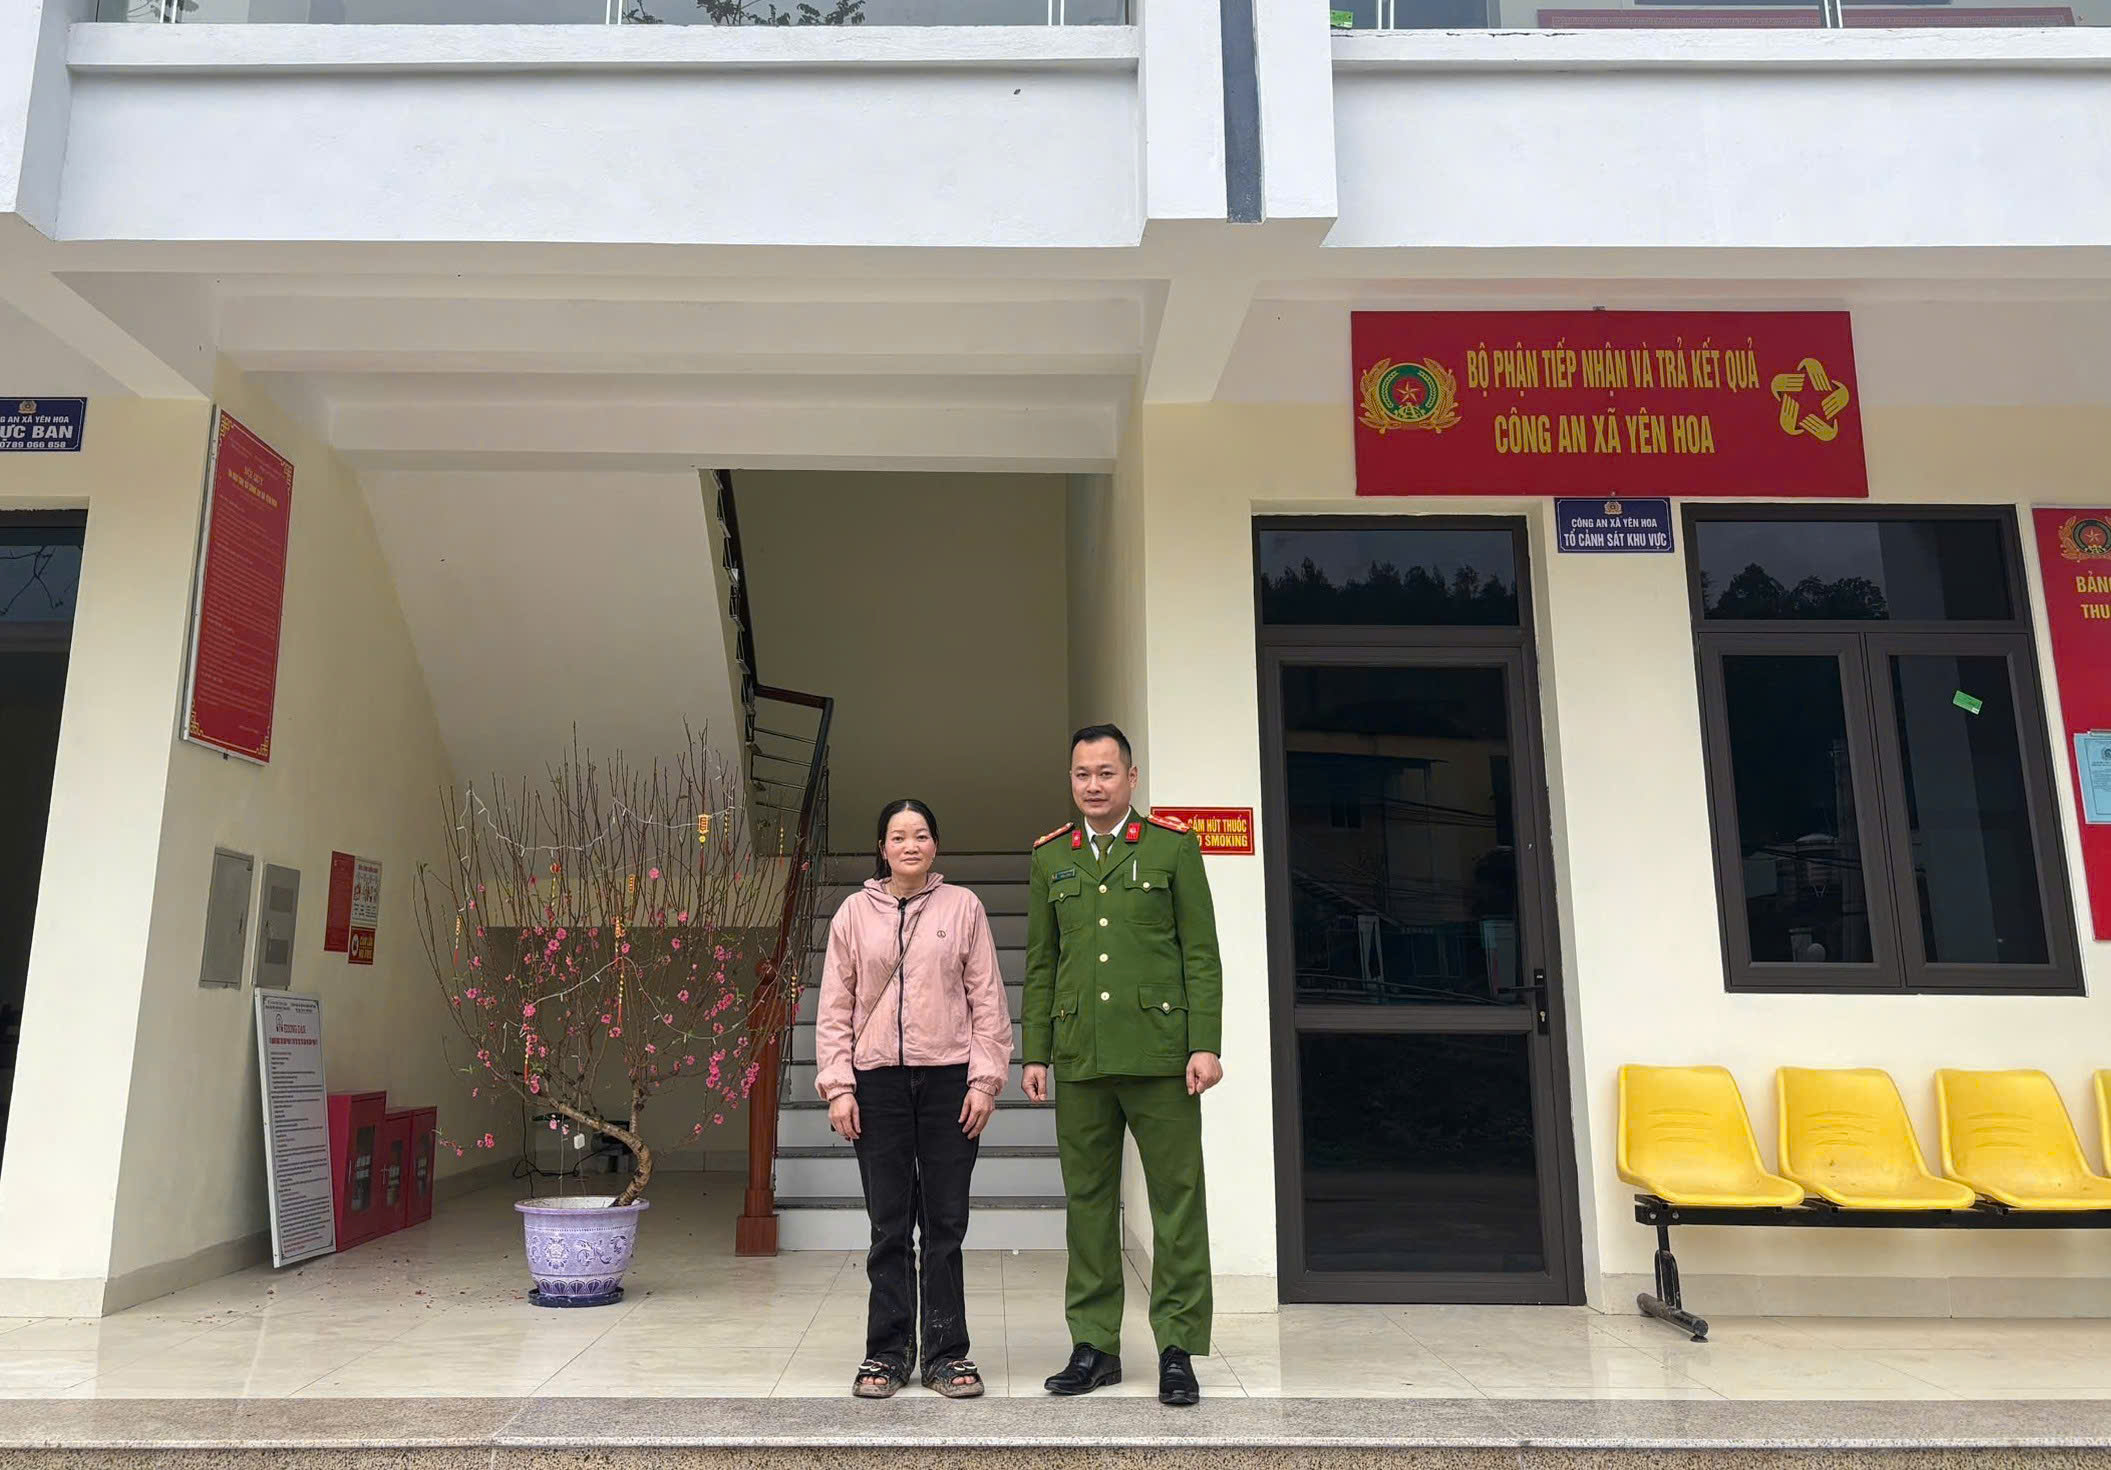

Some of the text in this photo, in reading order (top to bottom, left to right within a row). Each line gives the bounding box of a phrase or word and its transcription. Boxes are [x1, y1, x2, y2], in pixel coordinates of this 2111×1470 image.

[1467, 337, 1760, 397] BỘ PHẬN TIẾP NHẬN VÀ TRẢ KẾT QUẢ
[22, 415, 33, 423] XÃ
[35, 415, 51, 423] YÊN
[32, 425, 74, 439] BAN
[1495, 407, 1715, 453] CÔNG AN XÃ YÊN HOA
[1571, 516, 1658, 528] CÔNG AN XÃ YÊN HOA
[1564, 528, 1667, 549] TỔ CẢNH SÁT KHU VỰC
[2076, 570, 2111, 593] BẢN
[1207, 815, 1222, 833] HÚT
[1223, 814, 1248, 833] THUỐC
[1205, 834, 1249, 847] SMOKING
